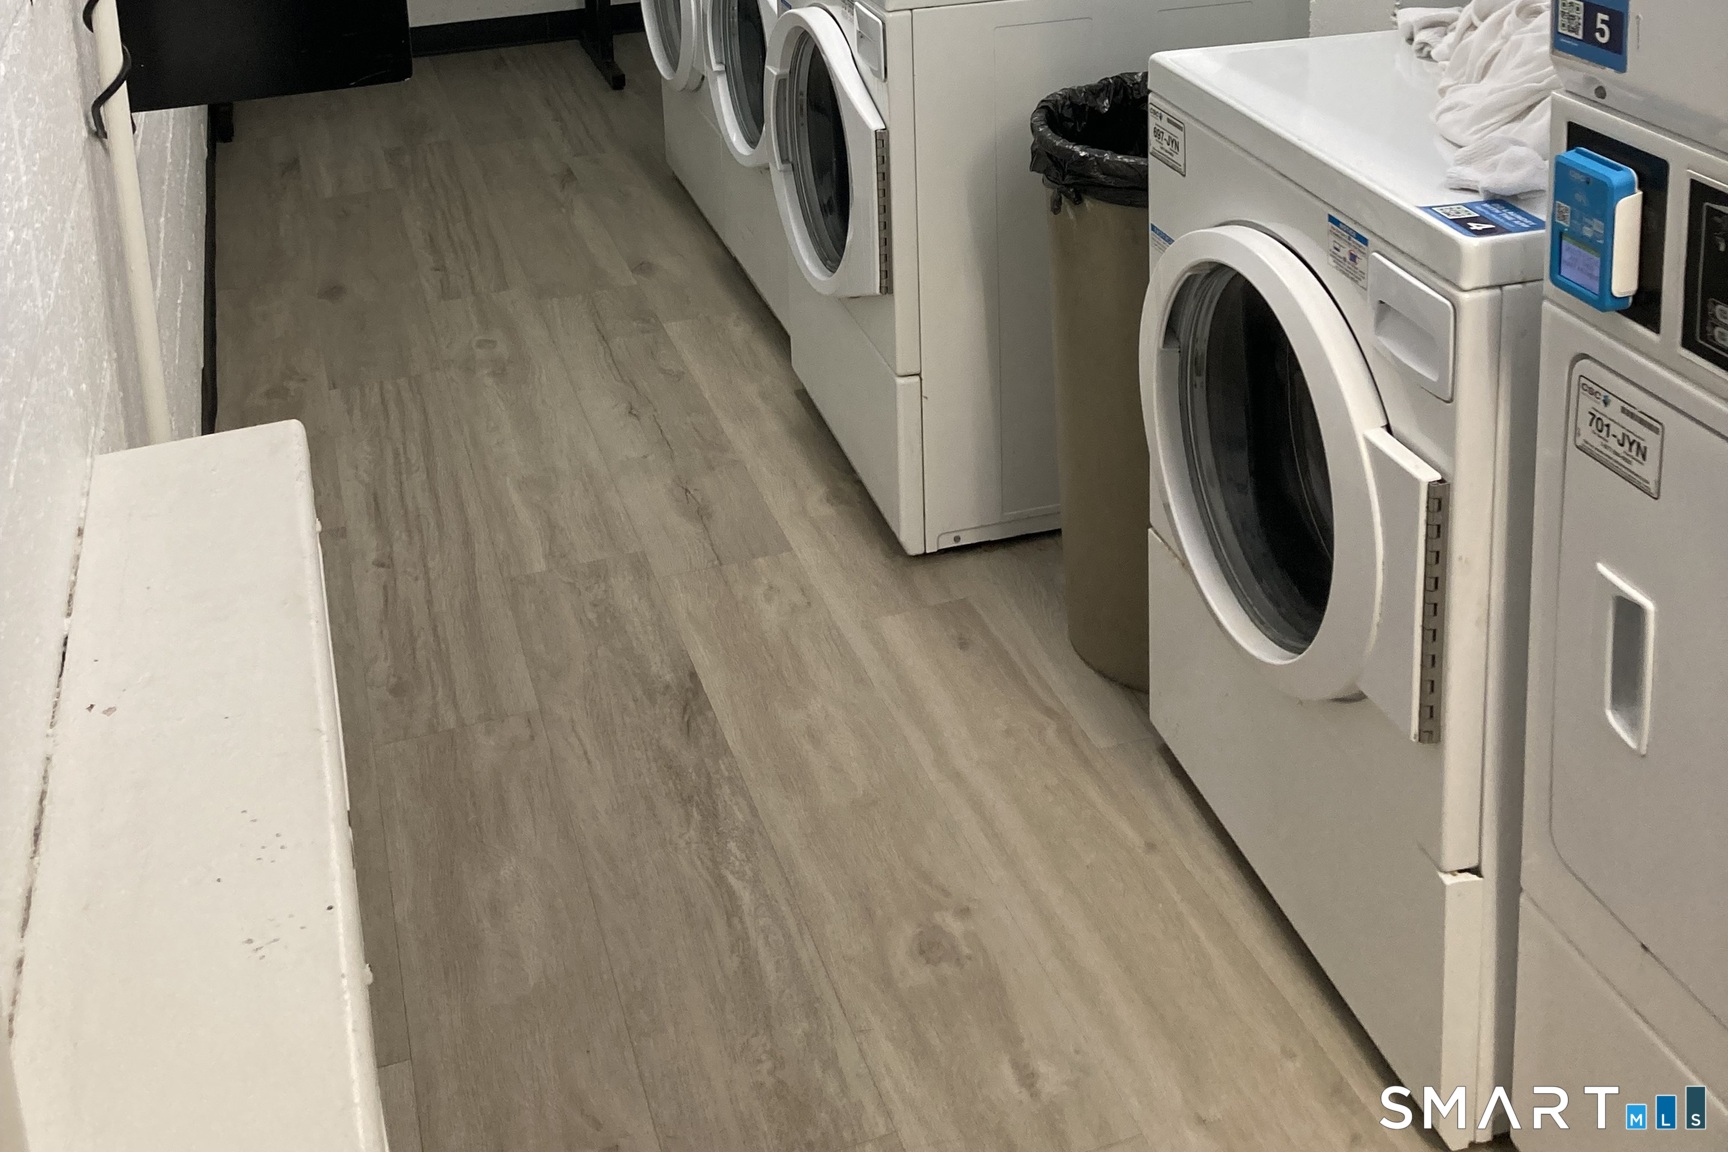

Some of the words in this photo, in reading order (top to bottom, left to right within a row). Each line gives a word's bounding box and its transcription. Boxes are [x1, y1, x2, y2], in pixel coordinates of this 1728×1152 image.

[1595, 13, 1610, 44] 5
[1153, 126, 1180, 152] 697-JYN
[1467, 221, 1496, 231] 4
[1581, 383, 1602, 400] CSC
[1588, 411, 1648, 462] 701-JYN
